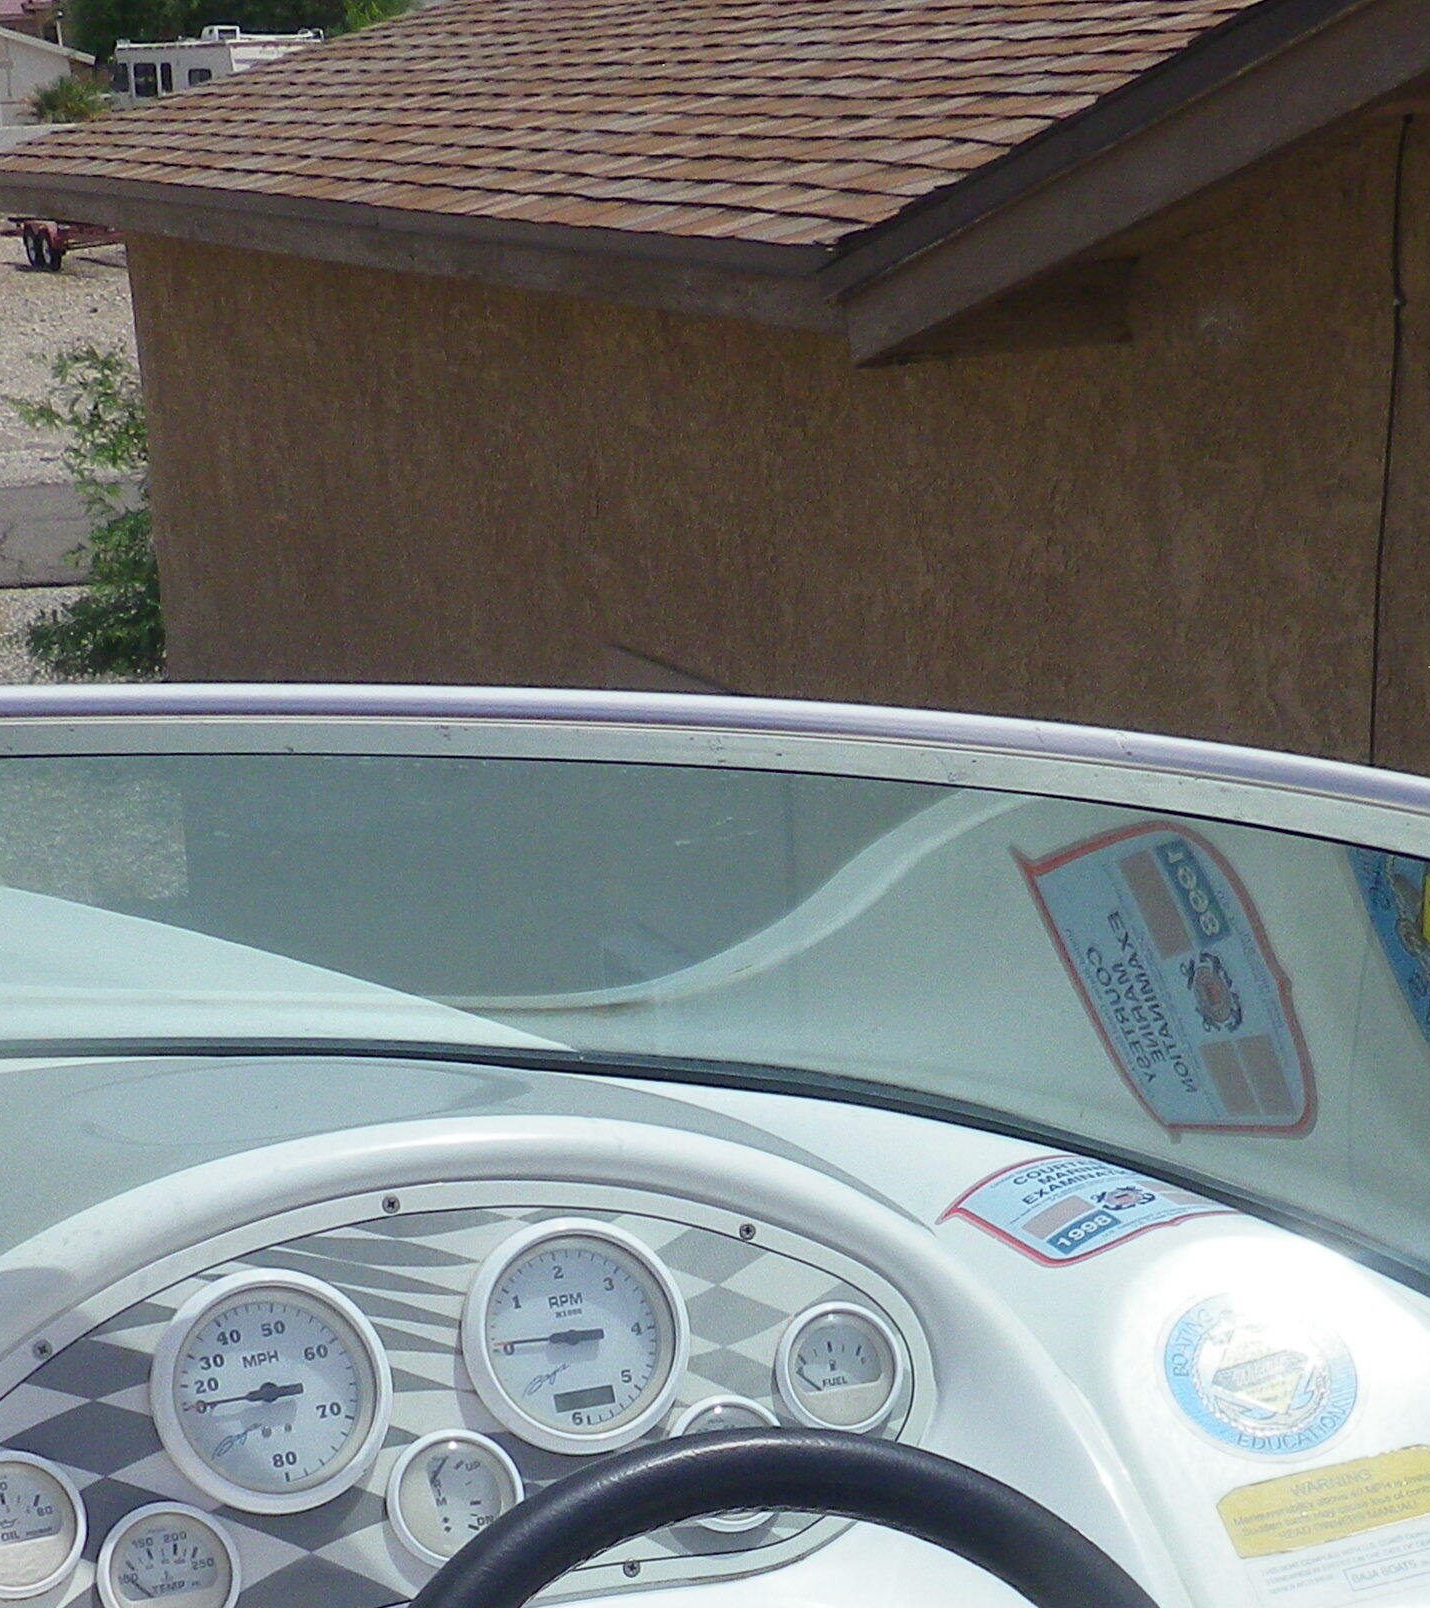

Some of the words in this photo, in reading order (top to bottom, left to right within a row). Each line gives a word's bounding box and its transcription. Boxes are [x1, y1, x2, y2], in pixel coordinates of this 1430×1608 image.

[1057, 1215, 1113, 1249] 1998
[552, 1265, 564, 1280] 2
[603, 1277, 615, 1291] 3
[512, 1295, 522, 1309] 1
[548, 1292, 583, 1308] RPM
[261, 1320, 285, 1337] 50
[631, 1322, 642, 1336] 4
[217, 1329, 241, 1346] 40
[1172, 1308, 1213, 1377] BOATING
[242, 1351, 280, 1368] MPH
[304, 1344, 328, 1361] 60
[199, 1354, 224, 1370] 30
[621, 1369, 632, 1383] 5
[822, 1376, 848, 1387] FUEL
[194, 1377, 219, 1394] 20
[316, 1402, 342, 1419] 70
[572, 1411, 583, 1426] 6
[1237, 1403, 1347, 1450] EDUCATION
[272, 1451, 297, 1468] 80
[466, 1461, 481, 1471] UP
[1290, 1468, 1370, 1496] WARNING
[1, 1530, 20, 1541] OIL
[132, 1537, 153, 1548] 150
[163, 1531, 187, 1543] 200
[192, 1557, 215, 1570] 250
[1350, 1569, 1378, 1582] BAJA
[1380, 1560, 1417, 1575] BOATS
[153, 1580, 186, 1593] TEMP
